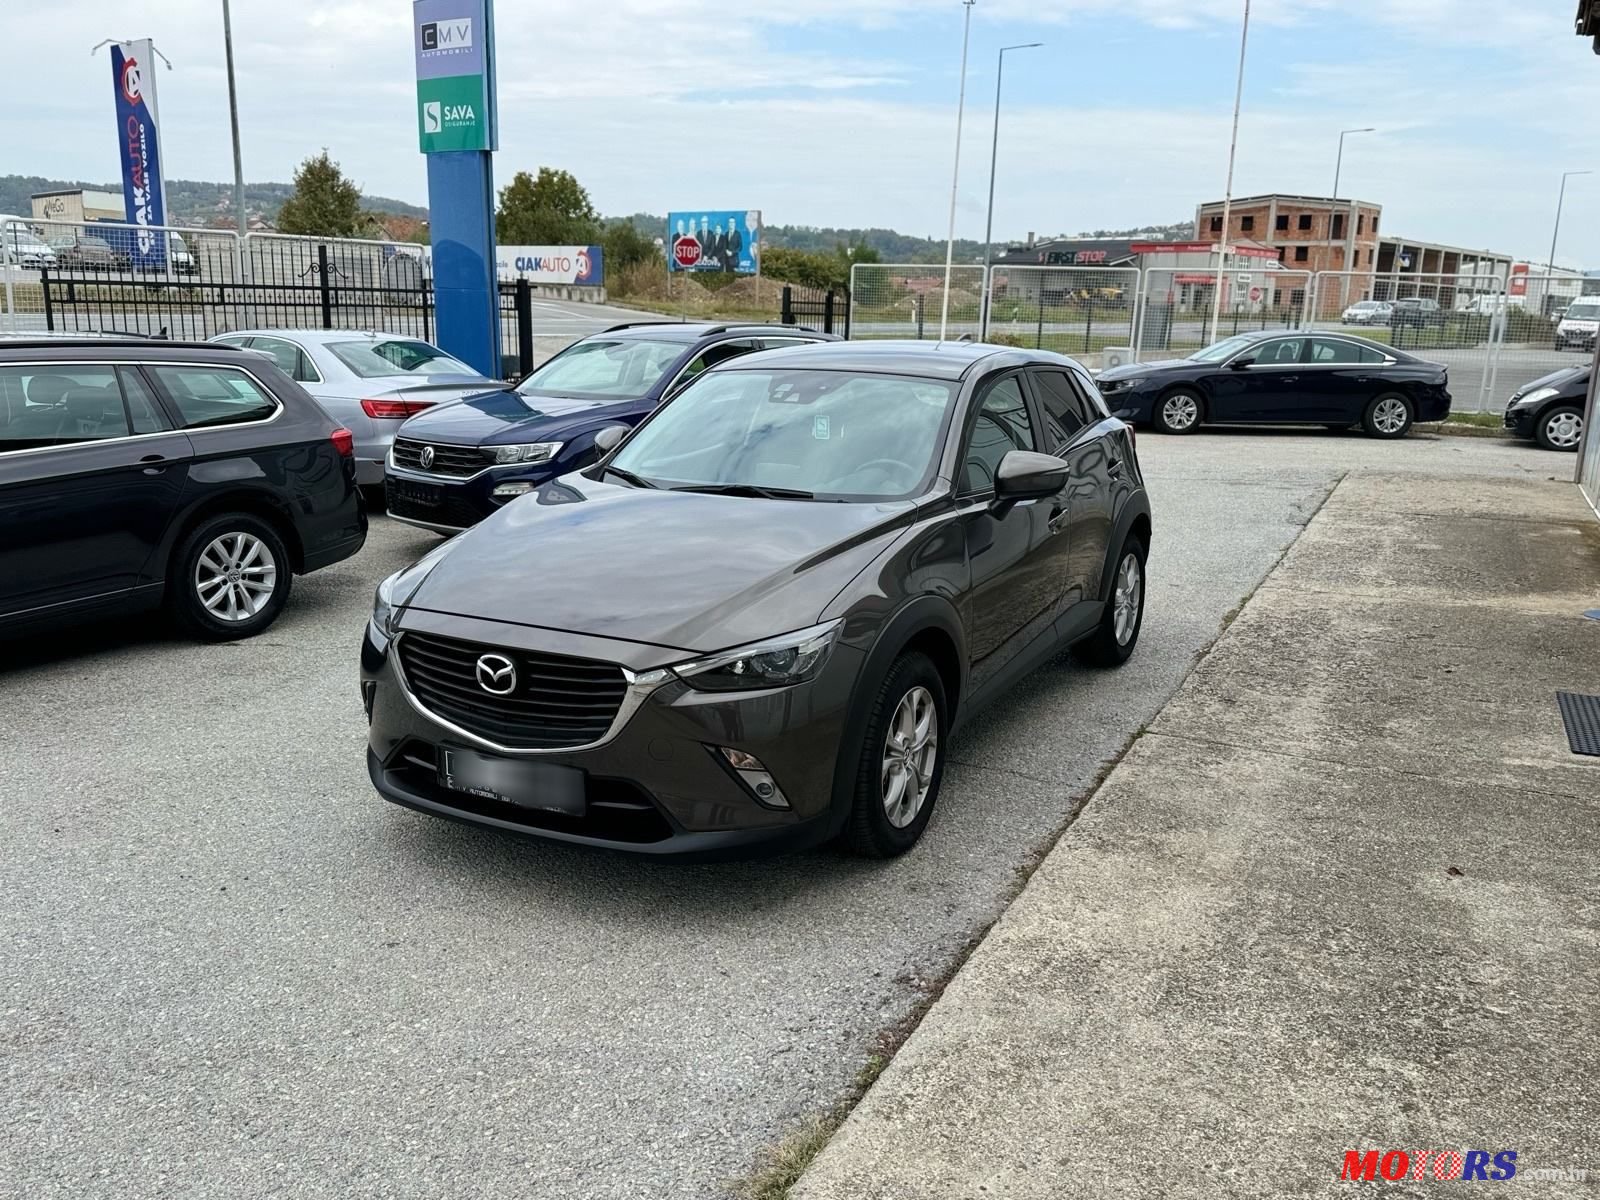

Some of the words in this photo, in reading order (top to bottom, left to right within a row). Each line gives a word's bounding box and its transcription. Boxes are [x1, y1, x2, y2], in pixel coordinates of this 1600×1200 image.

[424, 25, 469, 45] CMV
[421, 48, 473, 57] AUTOMOBILI
[444, 105, 475, 121] SAVA
[676, 246, 700, 258] STOP
[515, 257, 571, 272] CIAKAUTO
